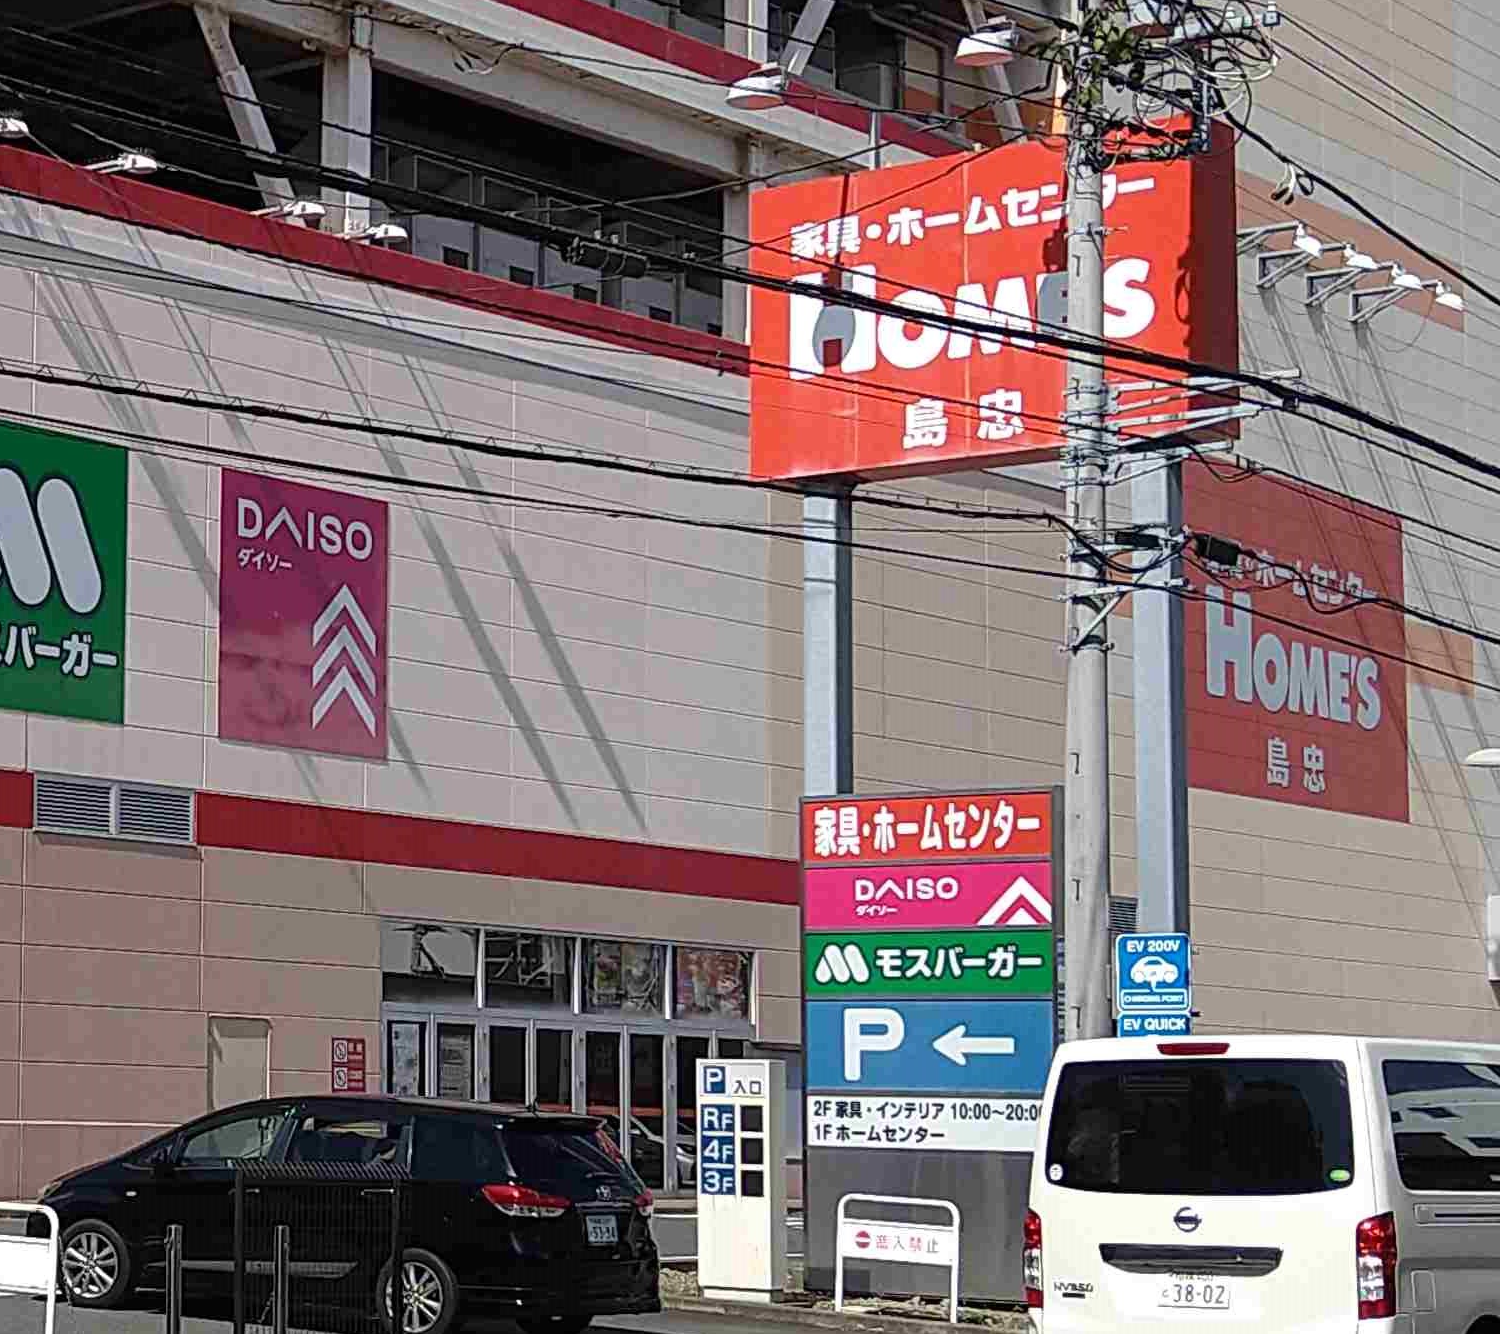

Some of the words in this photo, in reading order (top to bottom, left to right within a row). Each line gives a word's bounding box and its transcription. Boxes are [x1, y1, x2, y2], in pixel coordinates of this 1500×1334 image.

[236, 498, 374, 561] DAISO
[236, 547, 293, 573] ダイソー
[1204, 584, 1382, 731] HOME'S
[813, 800, 1041, 857] 家具・ホームセンター
[855, 877, 959, 902] DAISO
[855, 905, 898, 917] ダイソー
[1126, 940, 1145, 953] EV
[1148, 939, 1181, 953] 200V
[875, 945, 1043, 978] モスバーガー
[1123, 1018, 1141, 1031] EV
[1144, 1018, 1187, 1032] QUICK
[843, 1007, 906, 1082] P
[706, 1068, 723, 1092] P
[734, 1079, 762, 1095] 入口
[703, 1107, 734, 1131] RF
[813, 1100, 832, 1117] 2F
[835, 1100, 946, 1120] 家具・インテリア
[813, 1123, 832, 1140] 1F
[835, 1124, 946, 1143] ホームセンター
[703, 1139, 734, 1163] 4F
[703, 1170, 734, 1193] 3F
[1173, 1284, 1225, 1304] 38-02
